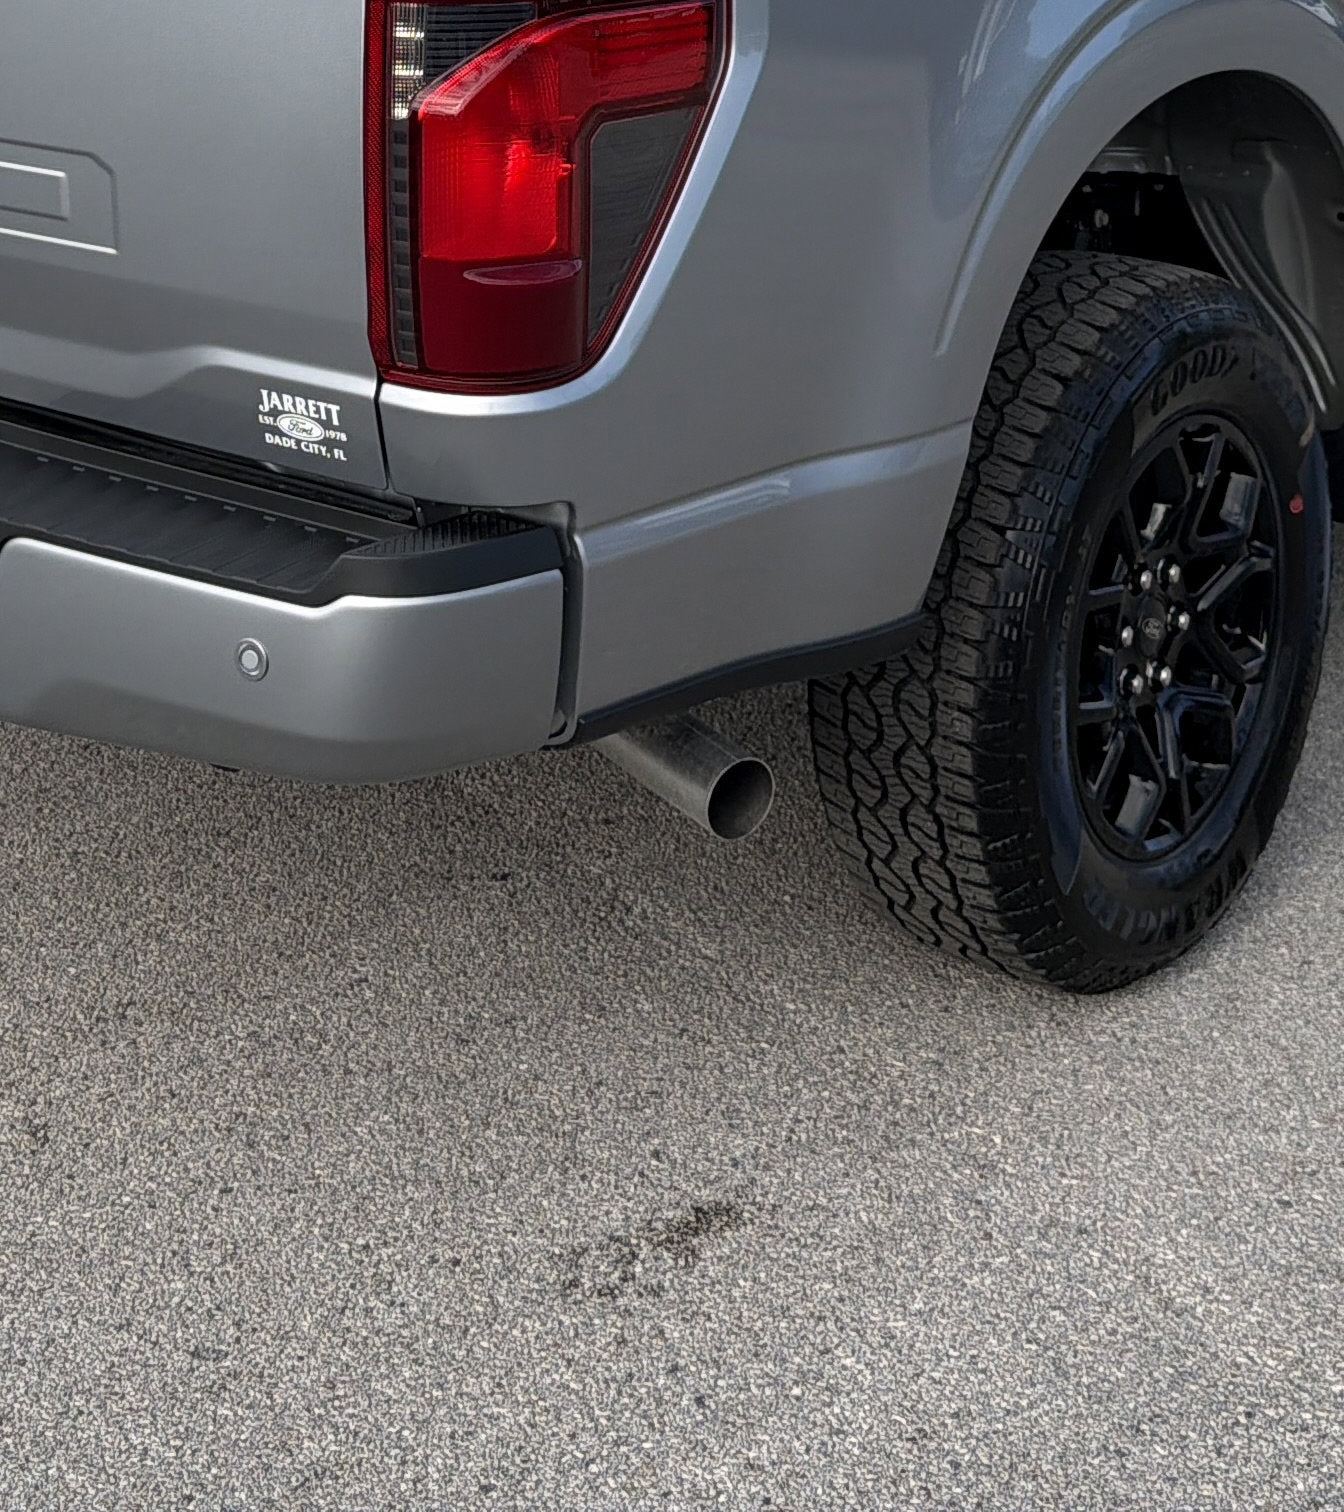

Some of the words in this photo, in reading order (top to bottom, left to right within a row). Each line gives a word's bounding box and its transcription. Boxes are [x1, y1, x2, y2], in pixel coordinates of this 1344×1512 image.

[258, 388, 341, 426] JARRETT
[287, 418, 314, 436] Ford
[264, 432, 298, 450] DADE
[300, 441, 331, 459] CITY,
[333, 448, 348, 461] FL
